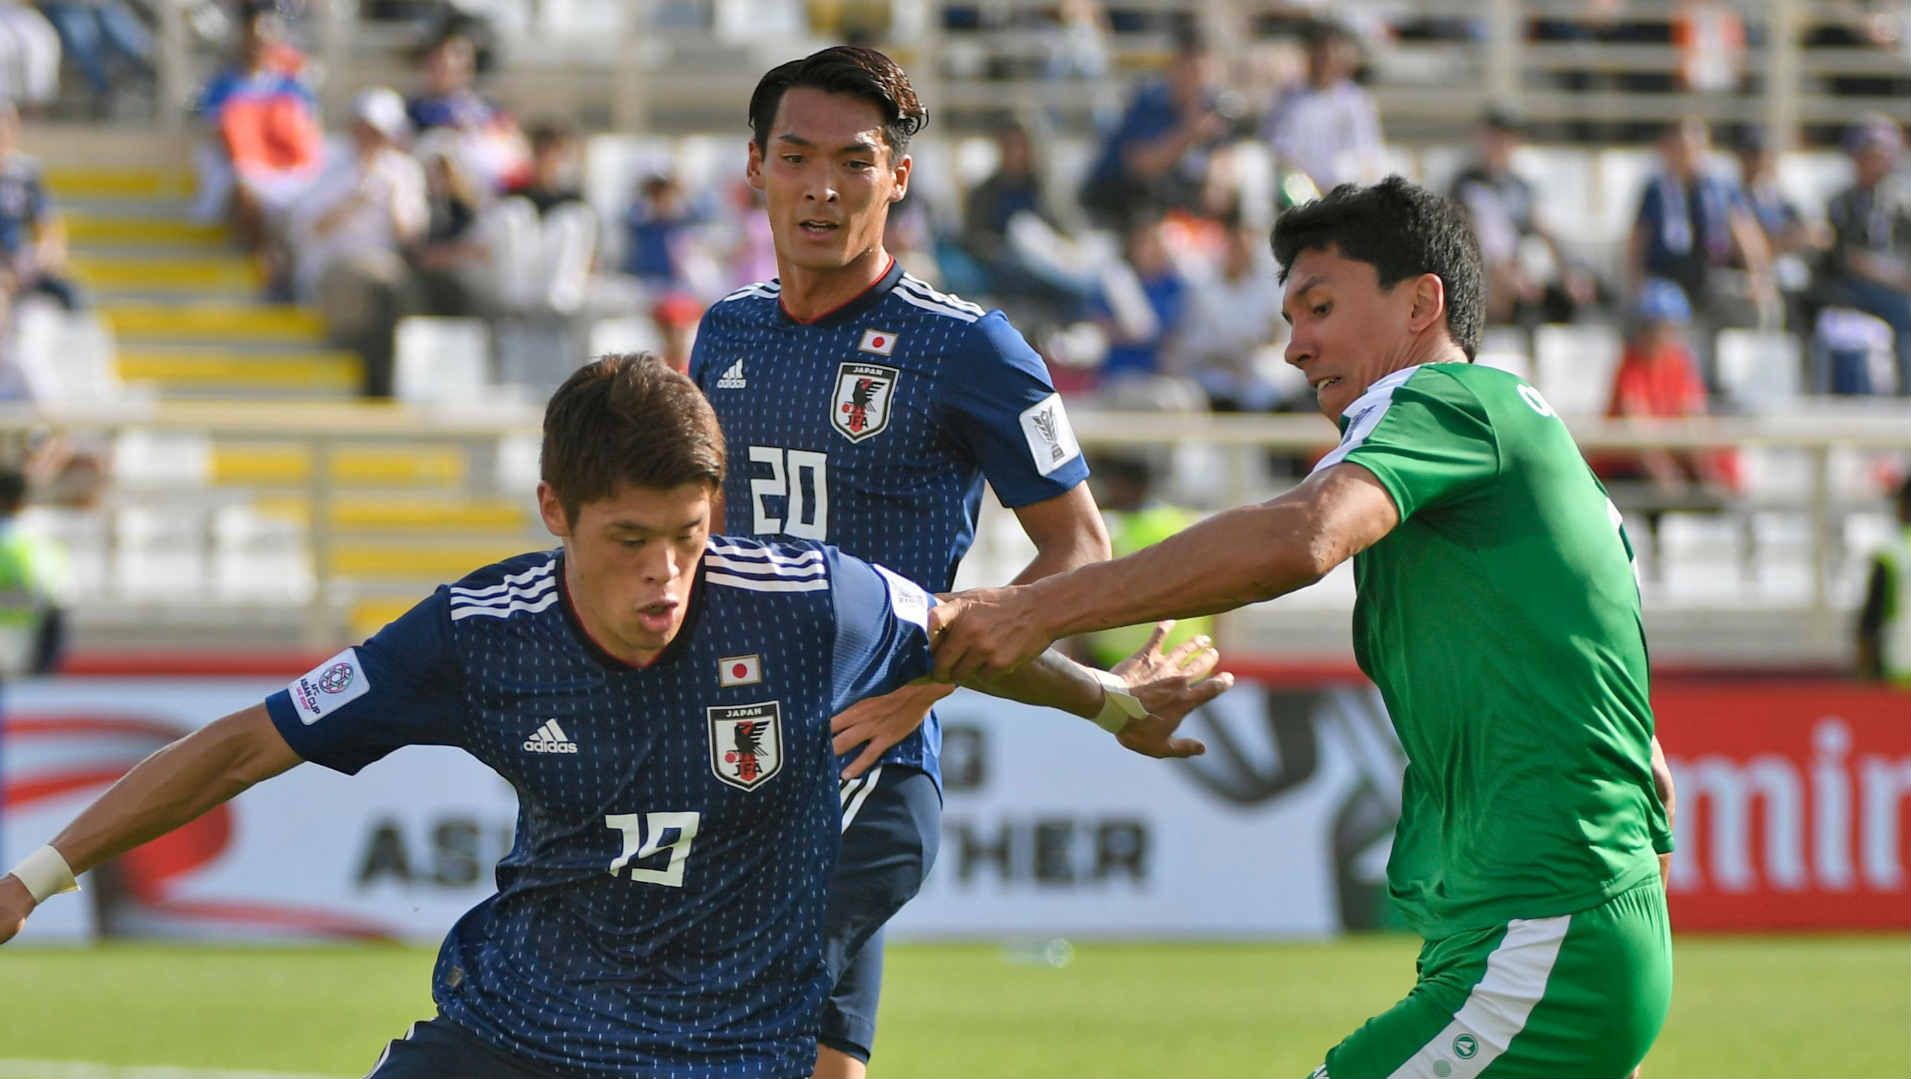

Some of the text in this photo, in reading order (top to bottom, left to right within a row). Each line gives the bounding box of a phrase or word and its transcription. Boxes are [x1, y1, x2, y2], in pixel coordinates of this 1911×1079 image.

[853, 366, 883, 376] JAPAN
[748, 445, 828, 542] 20
[307, 696, 321, 714] CUP
[726, 707, 762, 718] JAPAN
[523, 740, 578, 753] adidas
[733, 761, 763, 777] JFA
[605, 811, 700, 888] 19
